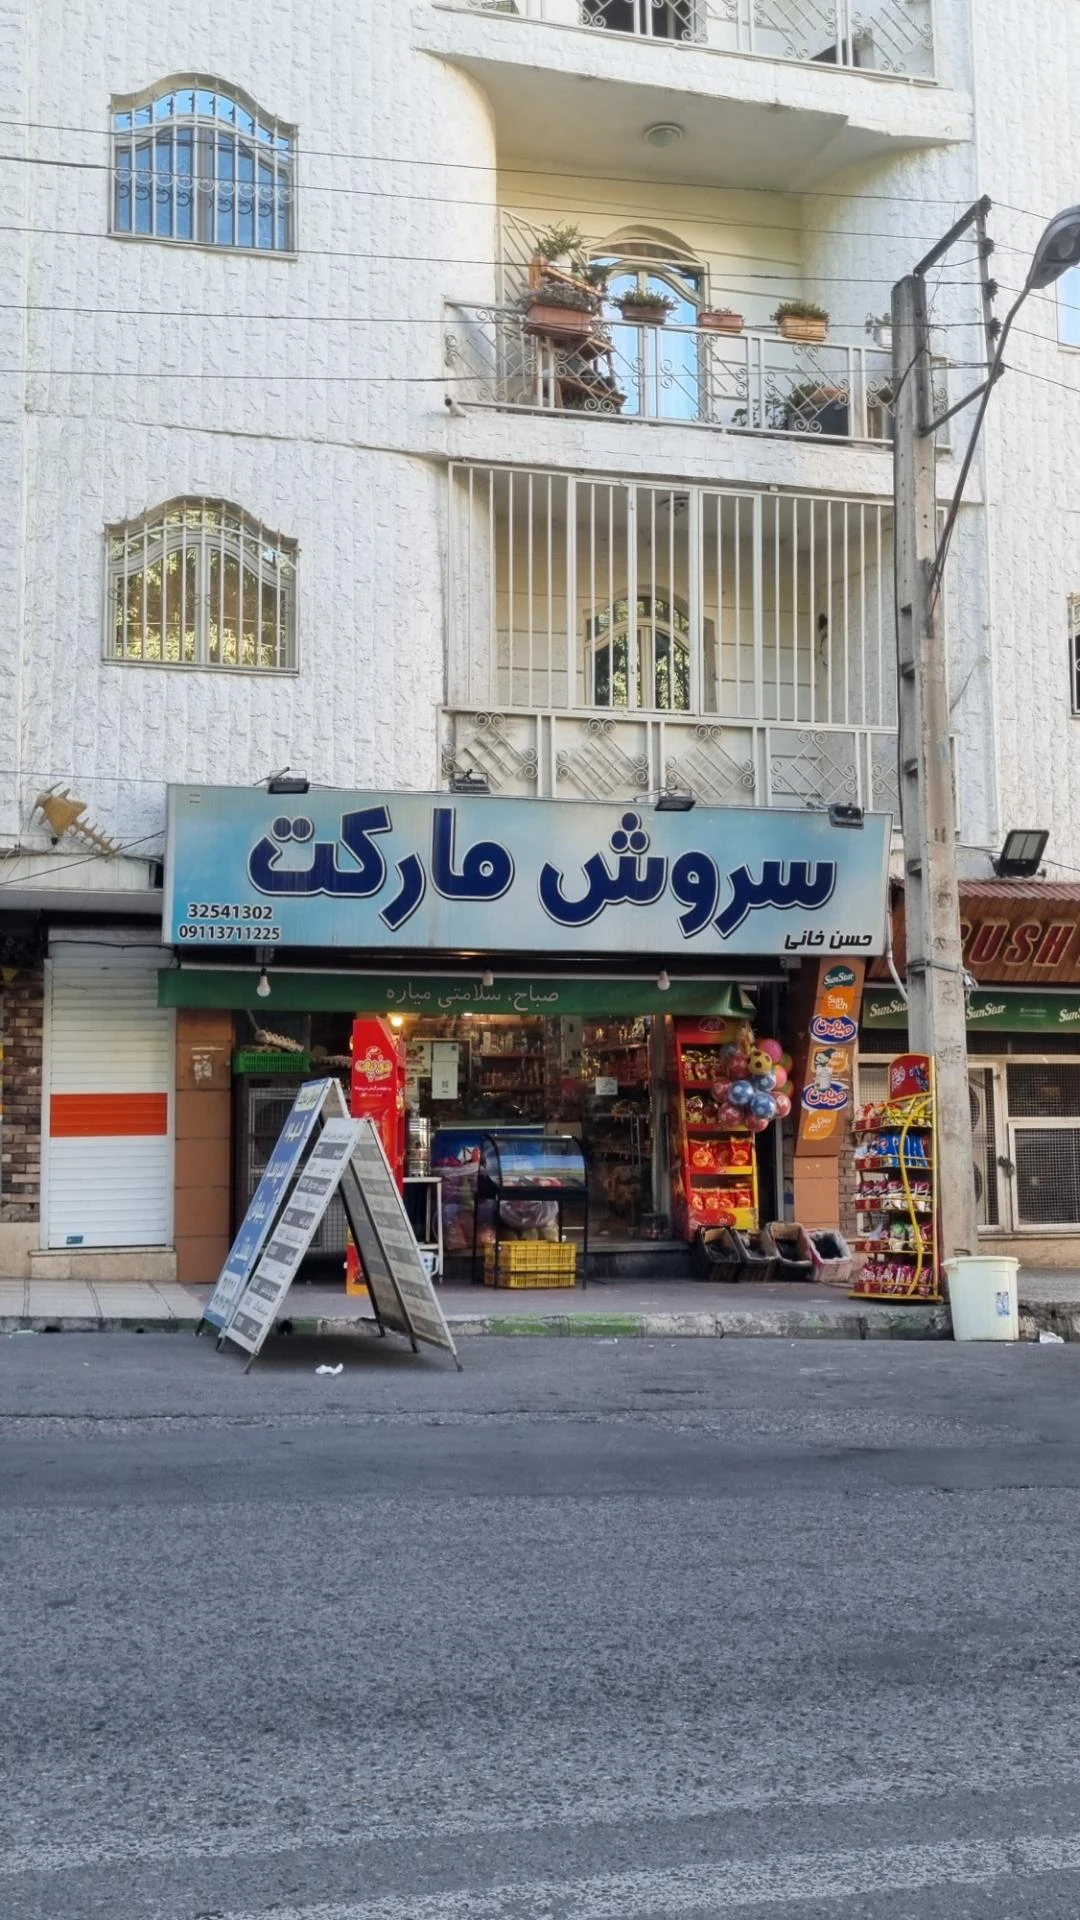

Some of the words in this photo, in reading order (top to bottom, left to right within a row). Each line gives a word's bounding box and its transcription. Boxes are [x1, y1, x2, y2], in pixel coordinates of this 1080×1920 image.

[247, 804, 515, 931] مارکت
[537, 811, 836, 939] سروش
[187, 903, 274, 921] 32541302
[178, 924, 281, 941] 09113711225
[784, 930, 825, 950] خانی
[829, 931, 873, 949] حسن
[437, 983, 502, 1009] سلامتی
[965, 1002, 1007, 1020] SunStar
